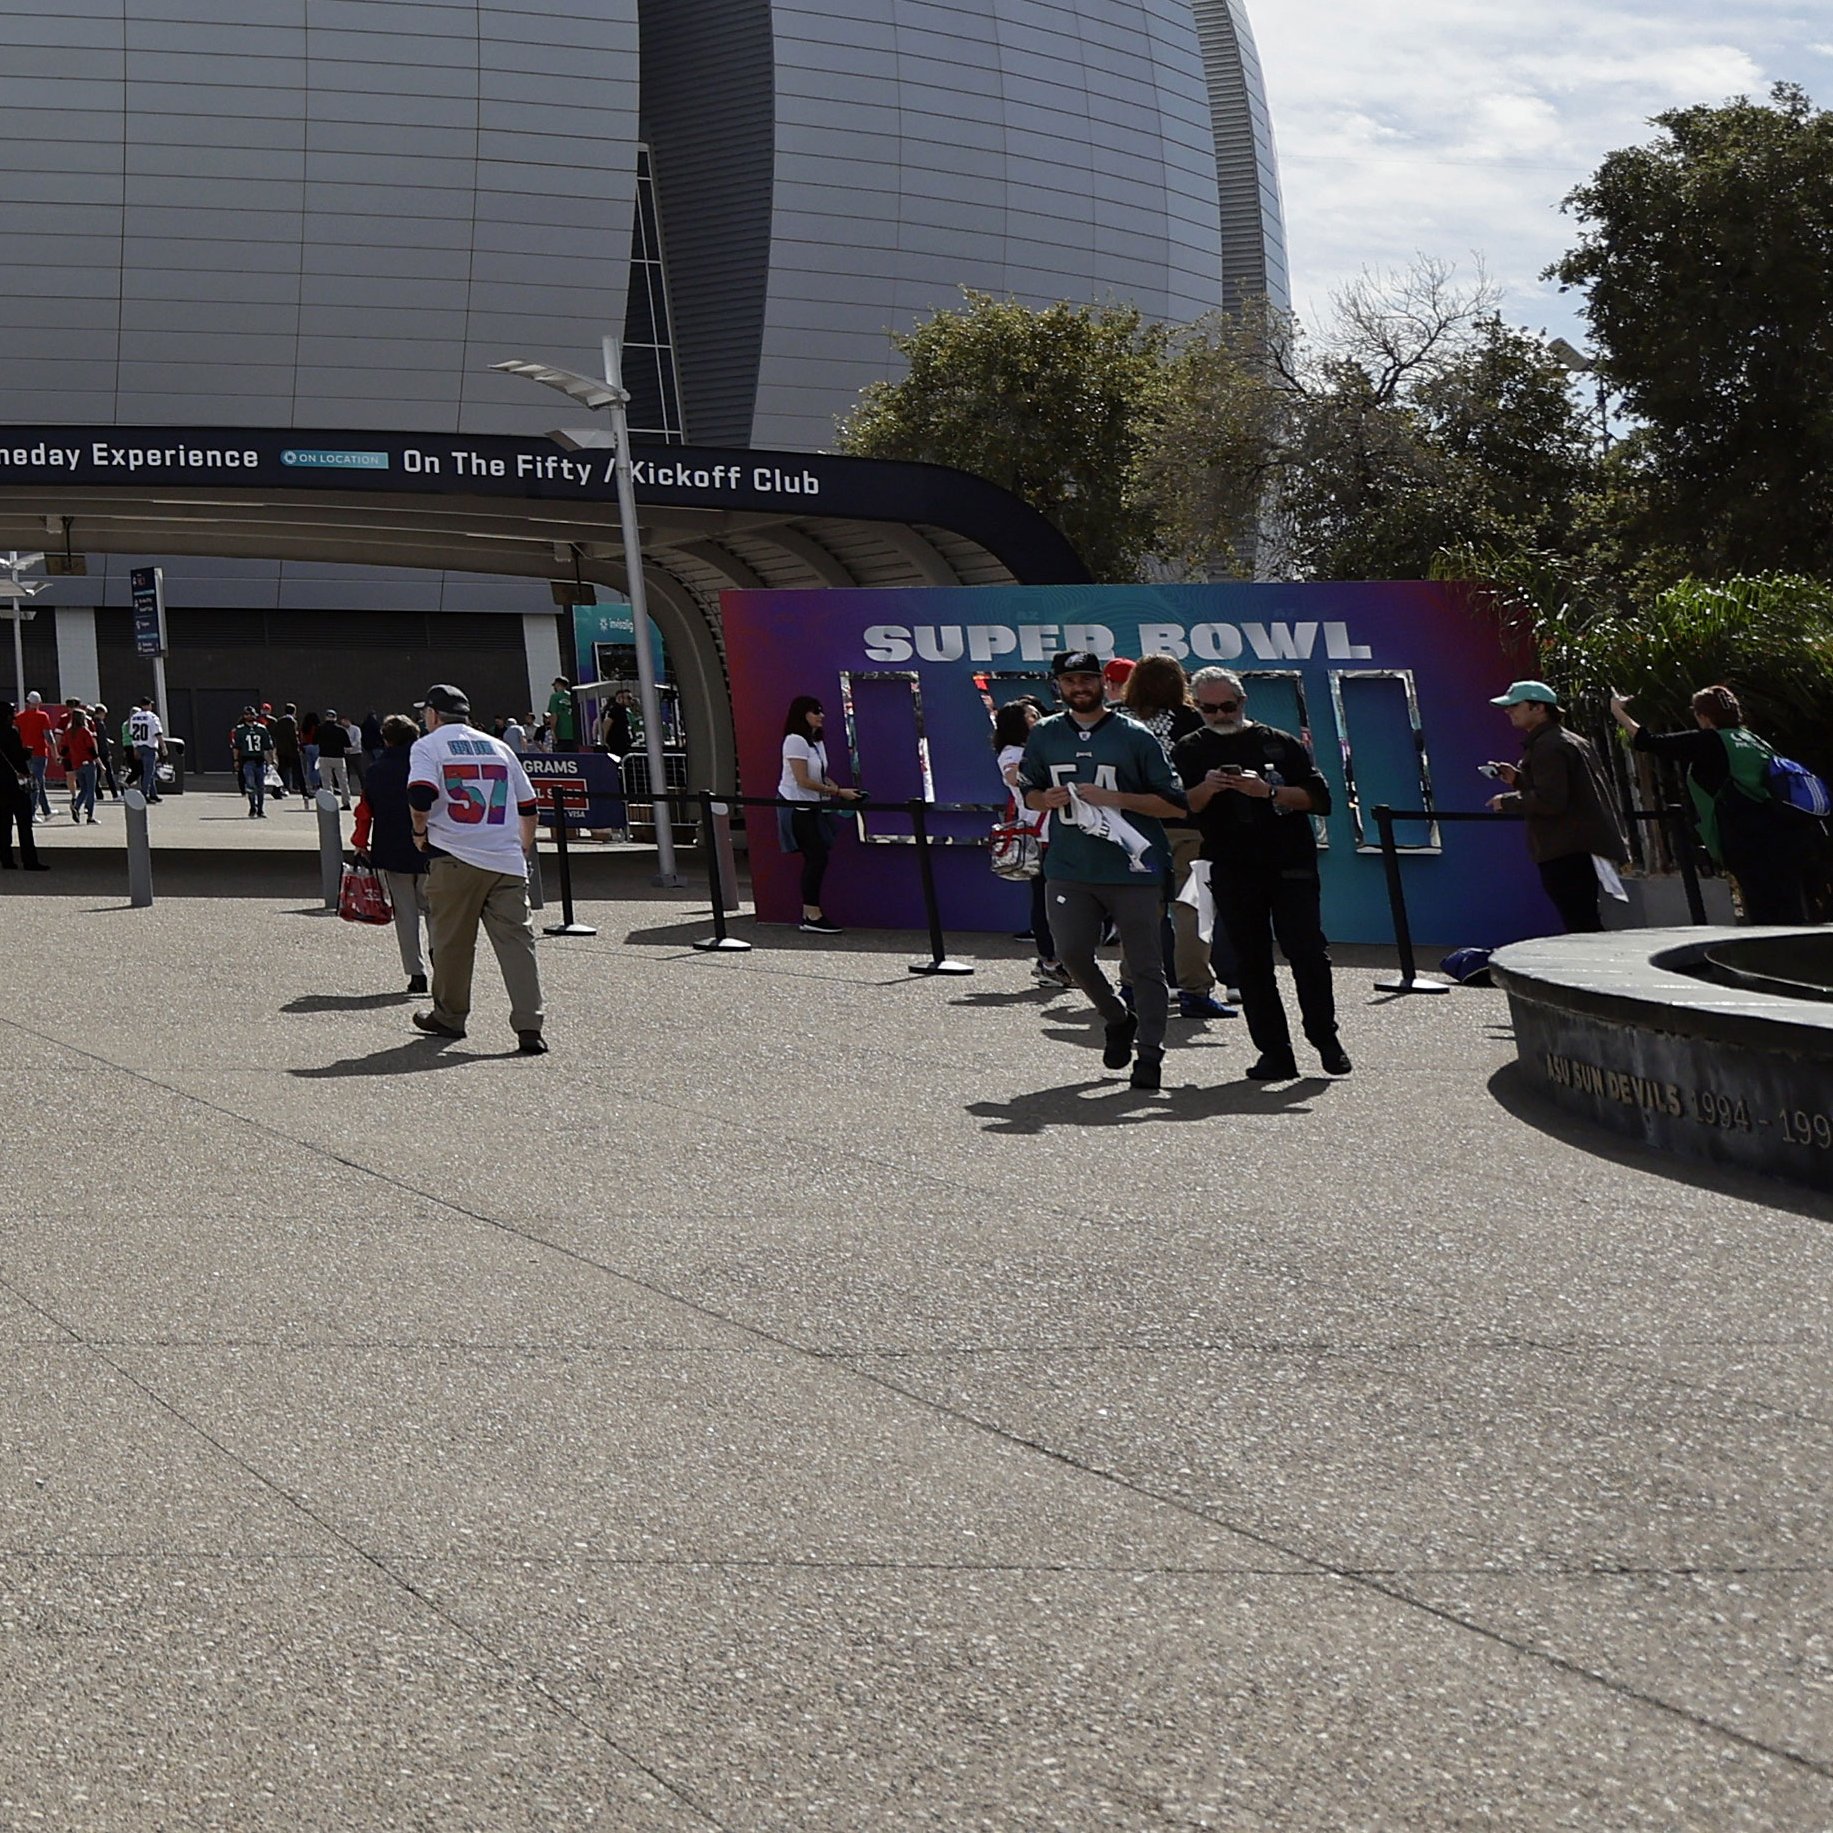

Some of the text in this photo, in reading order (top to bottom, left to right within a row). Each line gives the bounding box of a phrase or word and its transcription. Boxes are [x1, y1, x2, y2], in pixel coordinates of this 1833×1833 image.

[92, 442, 259, 471] Experience
[299, 453, 379, 465] ON LOCATION
[403, 450, 820, 495] On The Fifty / Kickoff Club
[608, 618, 634, 633] invisalig
[863, 621, 1372, 662] SUPER BOWL
[132, 723, 149, 741] 20
[245, 734, 261, 752] 13
[523, 759, 579, 774] GRAMS
[442, 764, 508, 825] 57
[1545, 1053, 1570, 1084] ASU
[1572, 1060, 1604, 1097] SUN
[1608, 1071, 1682, 1117] DEVILS
[1692, 1090, 1749, 1129] 1994
[1779, 1108, 1833, 1150] 199
